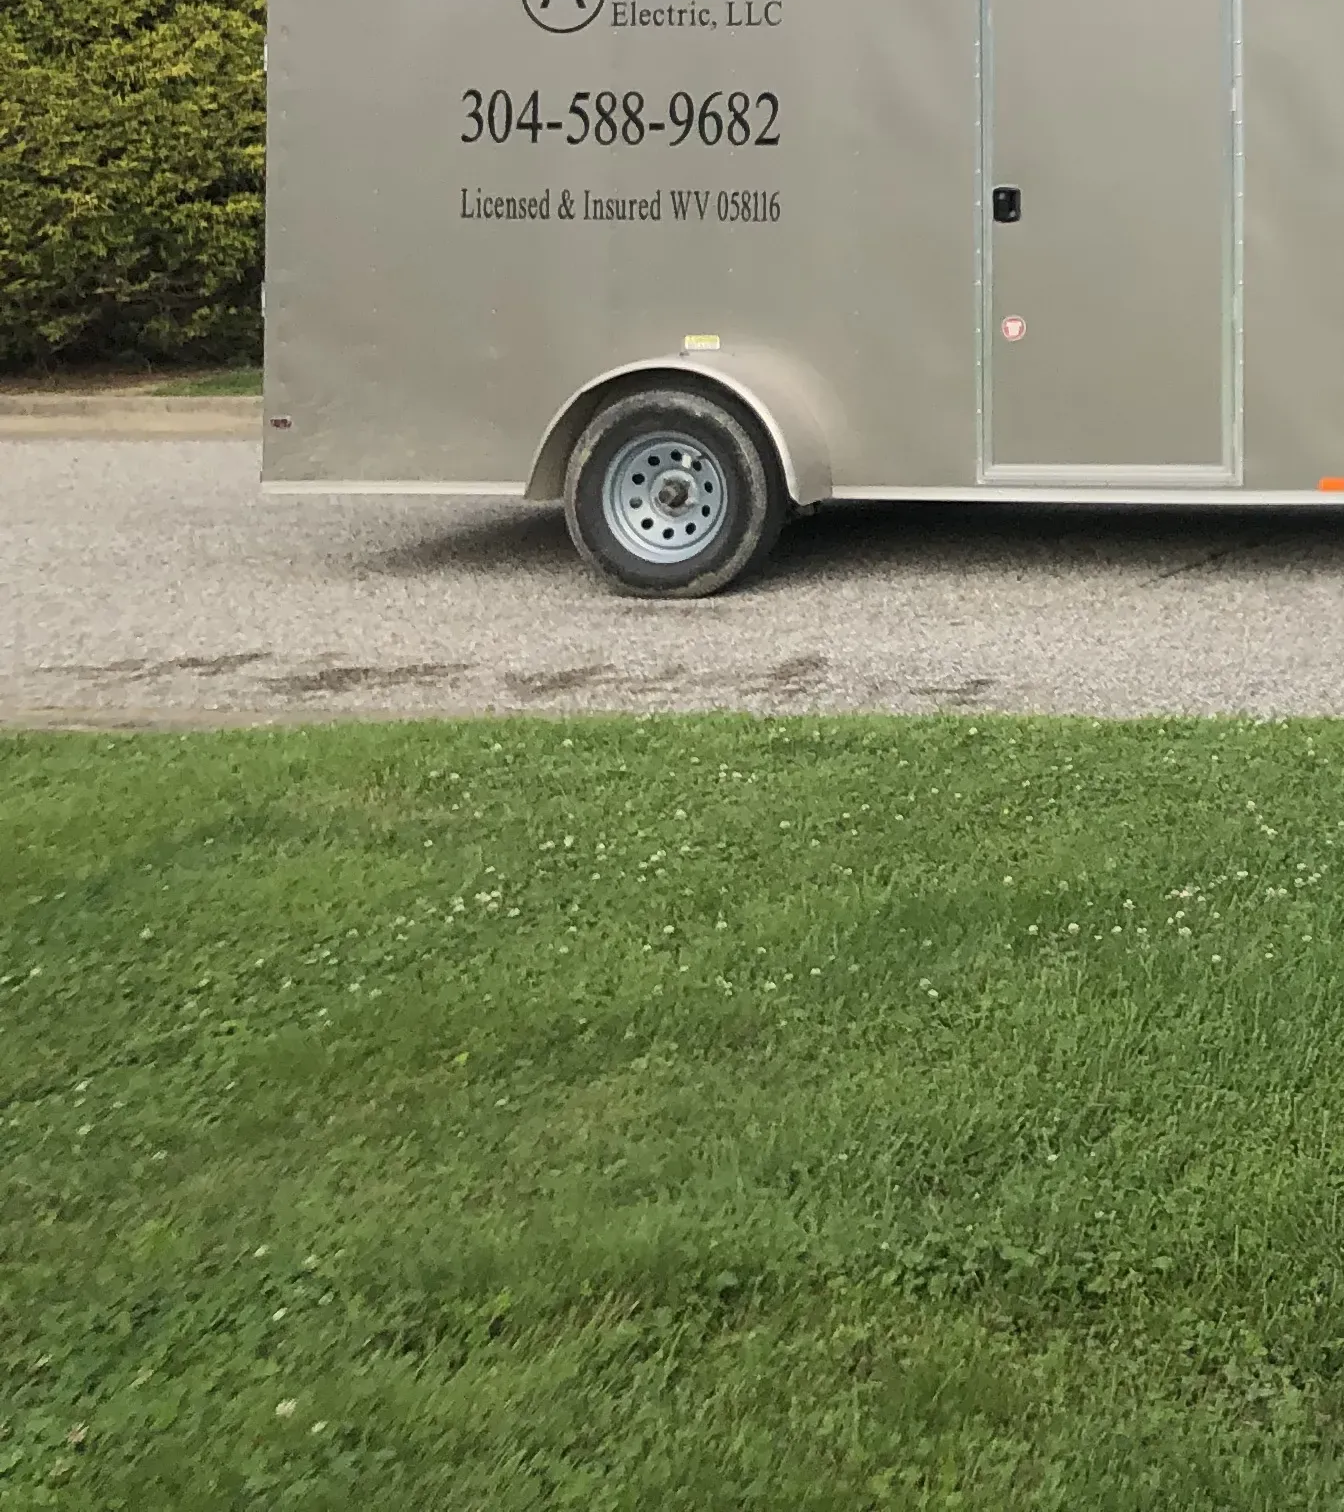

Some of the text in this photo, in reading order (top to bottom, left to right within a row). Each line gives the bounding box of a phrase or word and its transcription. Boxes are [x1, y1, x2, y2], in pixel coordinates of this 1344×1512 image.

[611, 1, 782, 29] Electric, LLC
[460, 89, 781, 146] 304-588-9682
[460, 188, 781, 222] Licensed & Insured WV 058116
